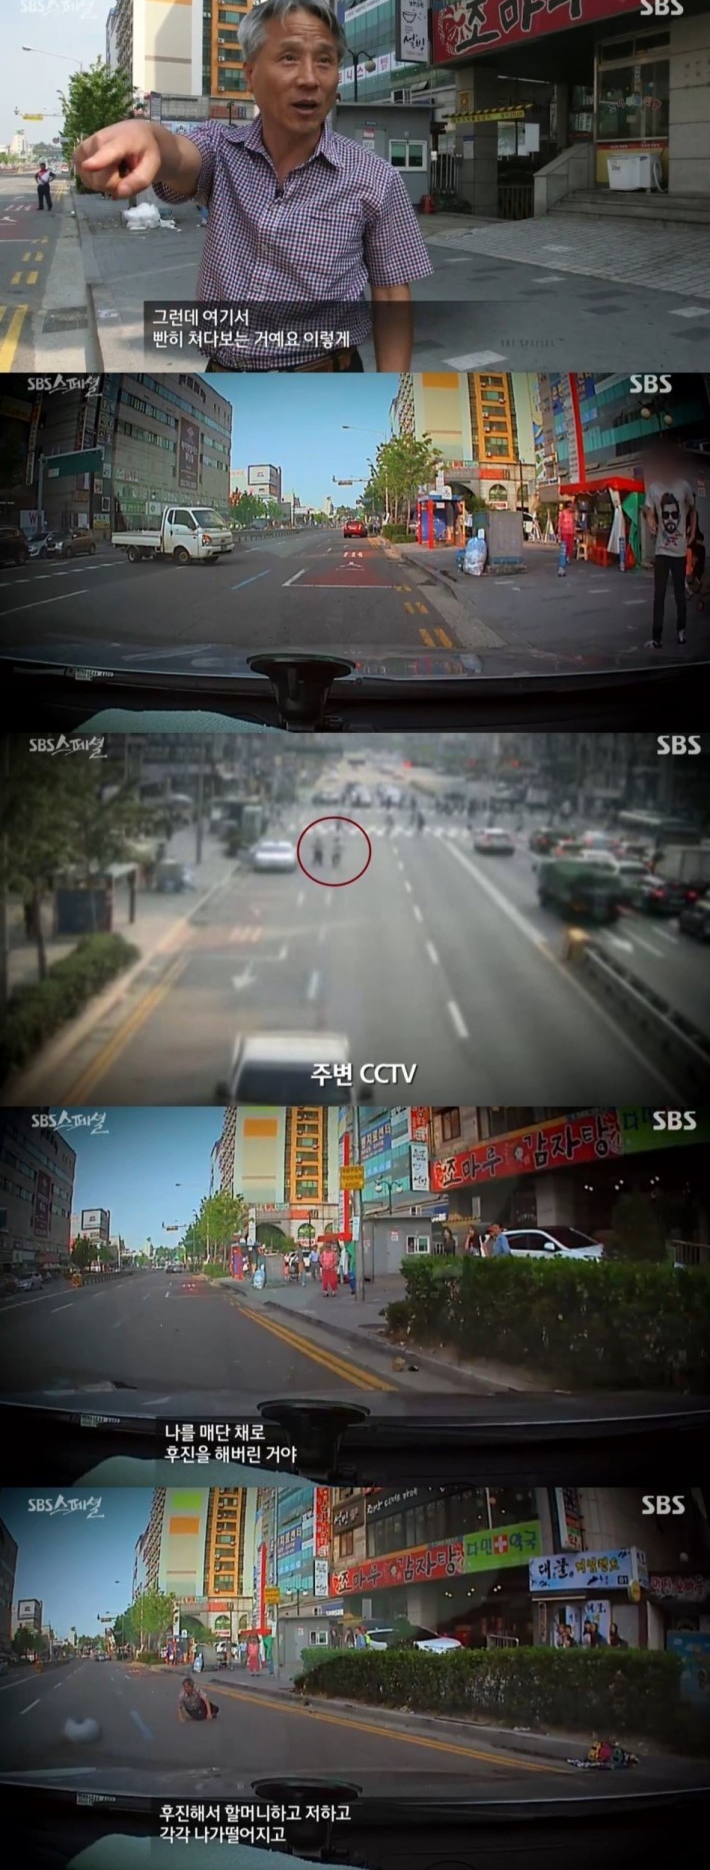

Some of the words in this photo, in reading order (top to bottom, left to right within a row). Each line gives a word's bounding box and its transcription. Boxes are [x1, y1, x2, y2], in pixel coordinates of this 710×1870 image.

[441, 1150, 502, 1187] 조마루
[523, 1117, 615, 1168] 감자탕
[466, 1534, 492, 1557] 다민
[509, 1530, 538, 1553] 약국
[337, 1569, 382, 1595] 조마루
[397, 1545, 461, 1581] 감자탕
